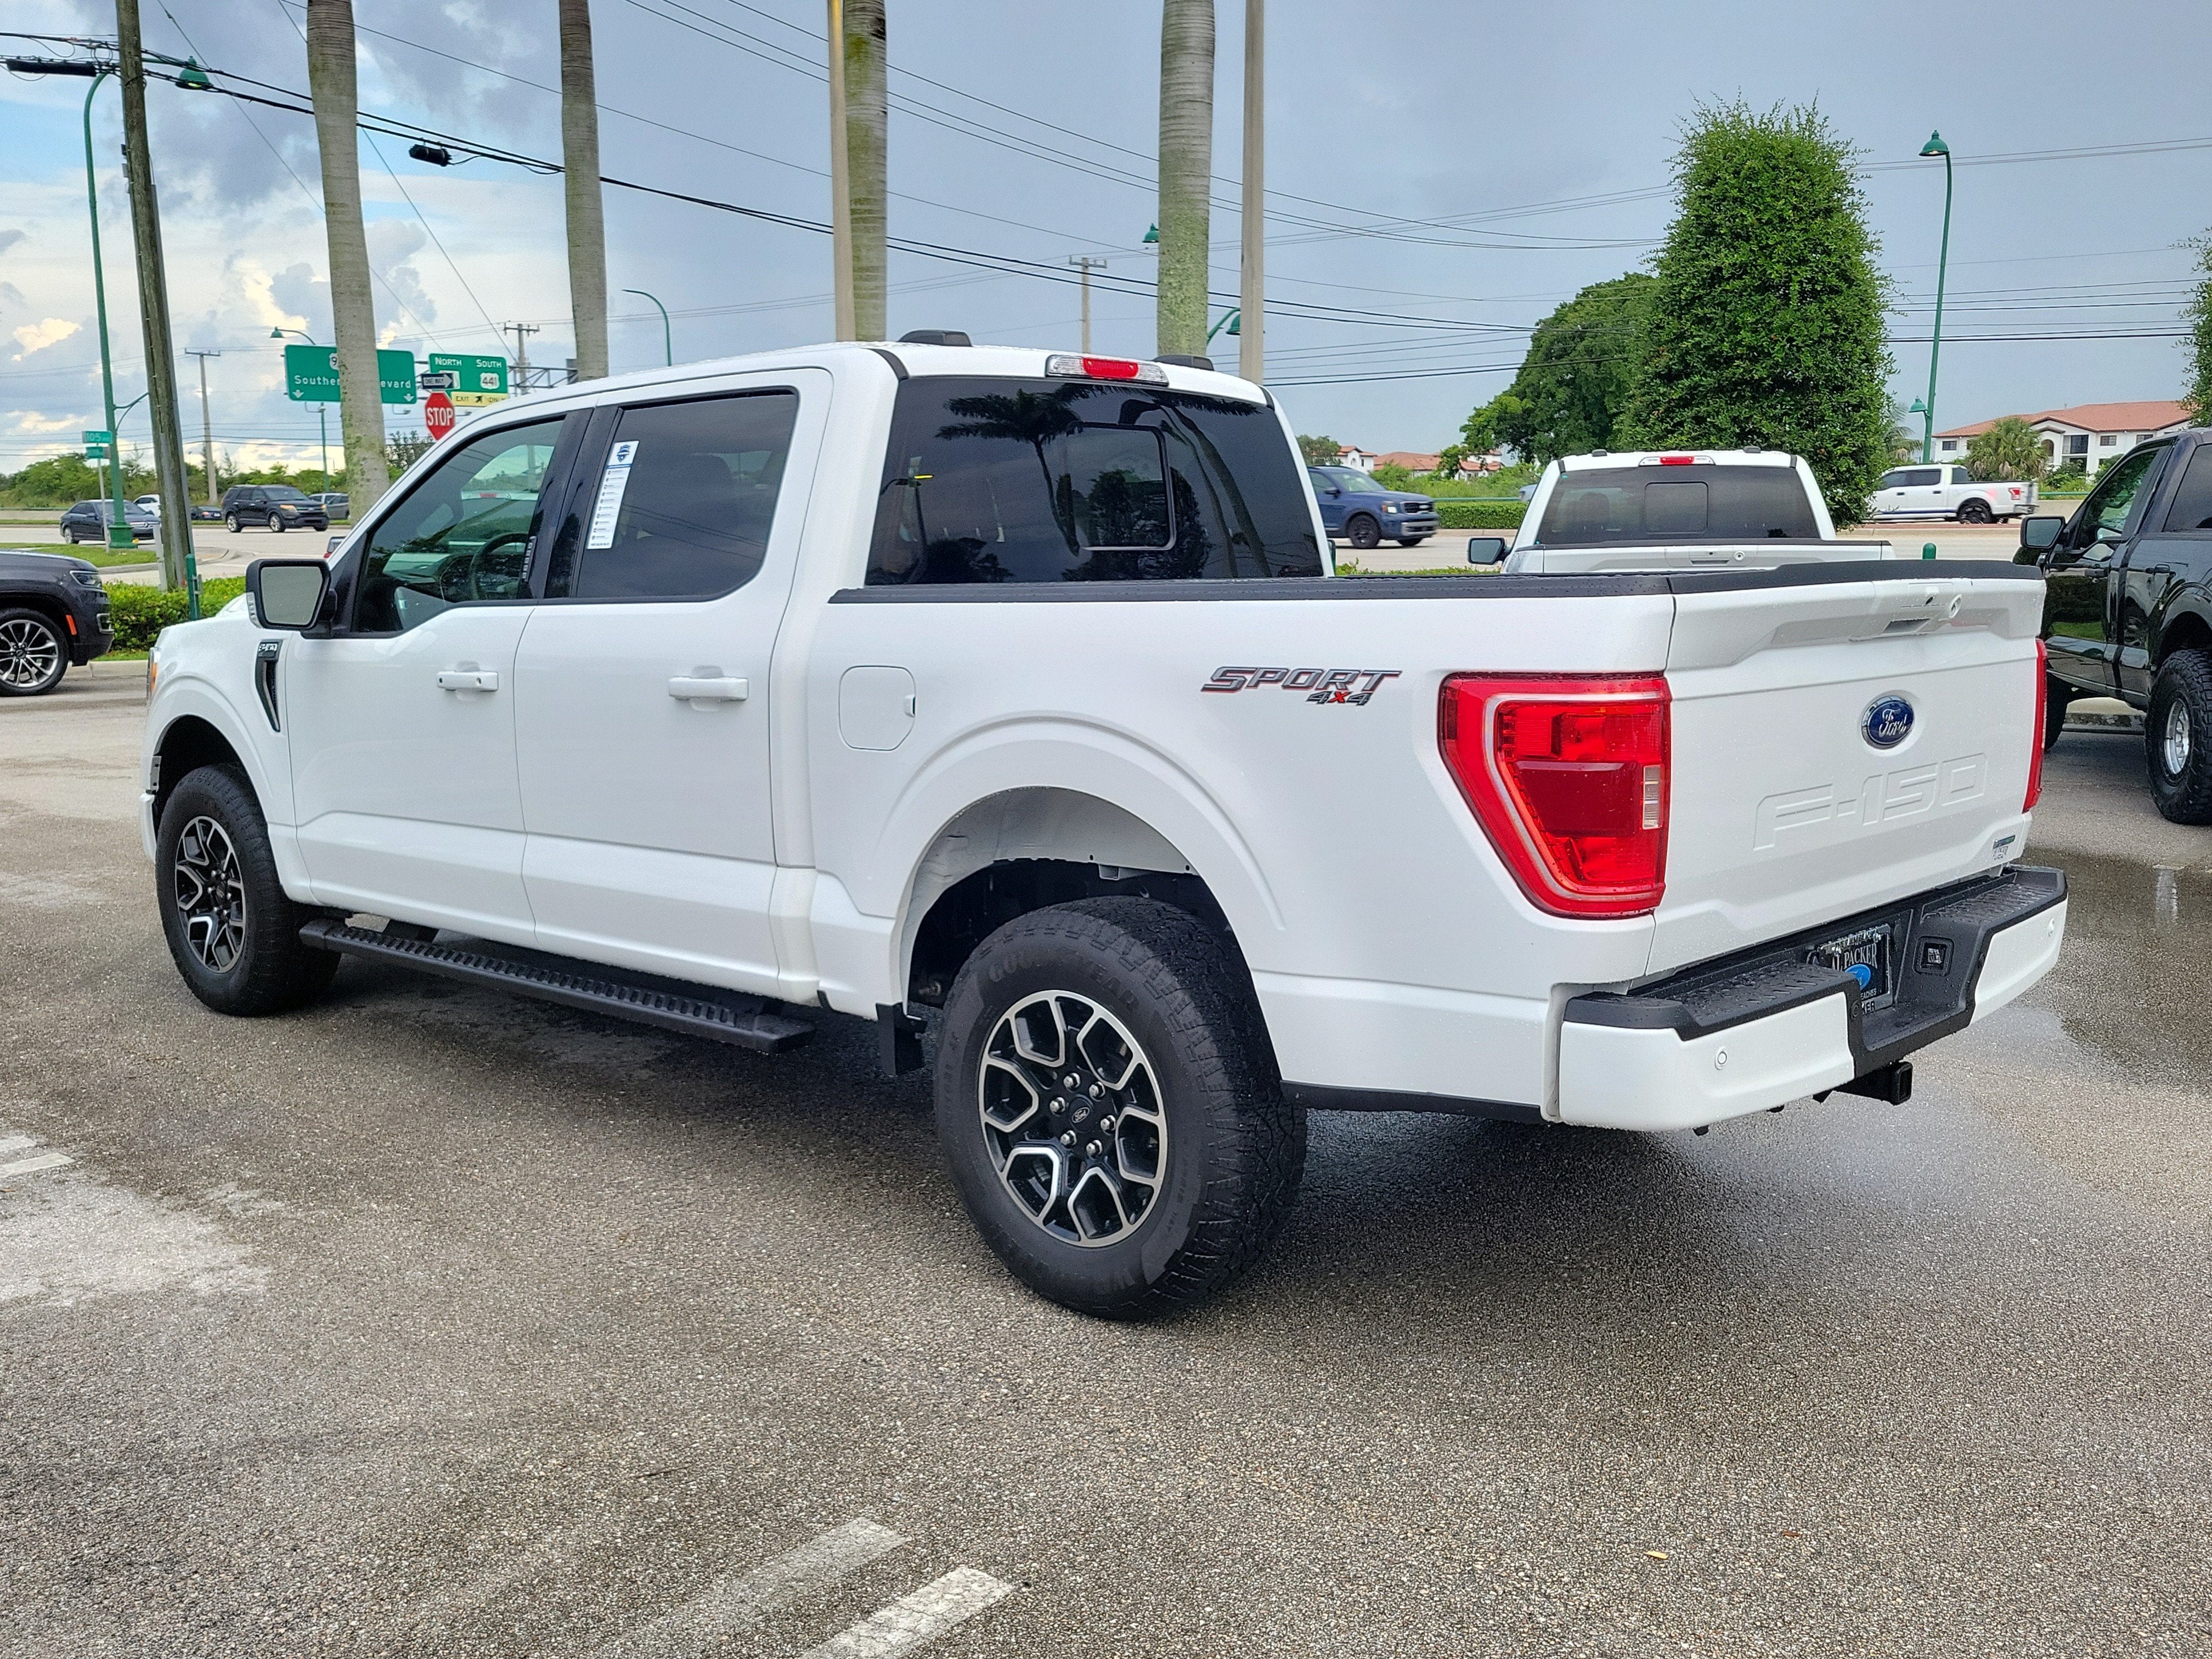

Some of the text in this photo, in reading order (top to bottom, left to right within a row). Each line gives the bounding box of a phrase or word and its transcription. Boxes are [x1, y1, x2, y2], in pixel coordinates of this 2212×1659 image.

[435, 357, 462, 366] NORTH
[476, 359, 502, 368] SOUTH
[294, 375, 340, 386] Souther
[380, 380, 411, 388] evard
[482, 377, 497, 386] 441
[427, 407, 454, 426] STOP
[1200, 665, 1403, 693] SPORT
[1878, 708, 1908, 737] Ford
[1753, 753, 1988, 851] F-150
[1844, 943, 1878, 969] PACKER
